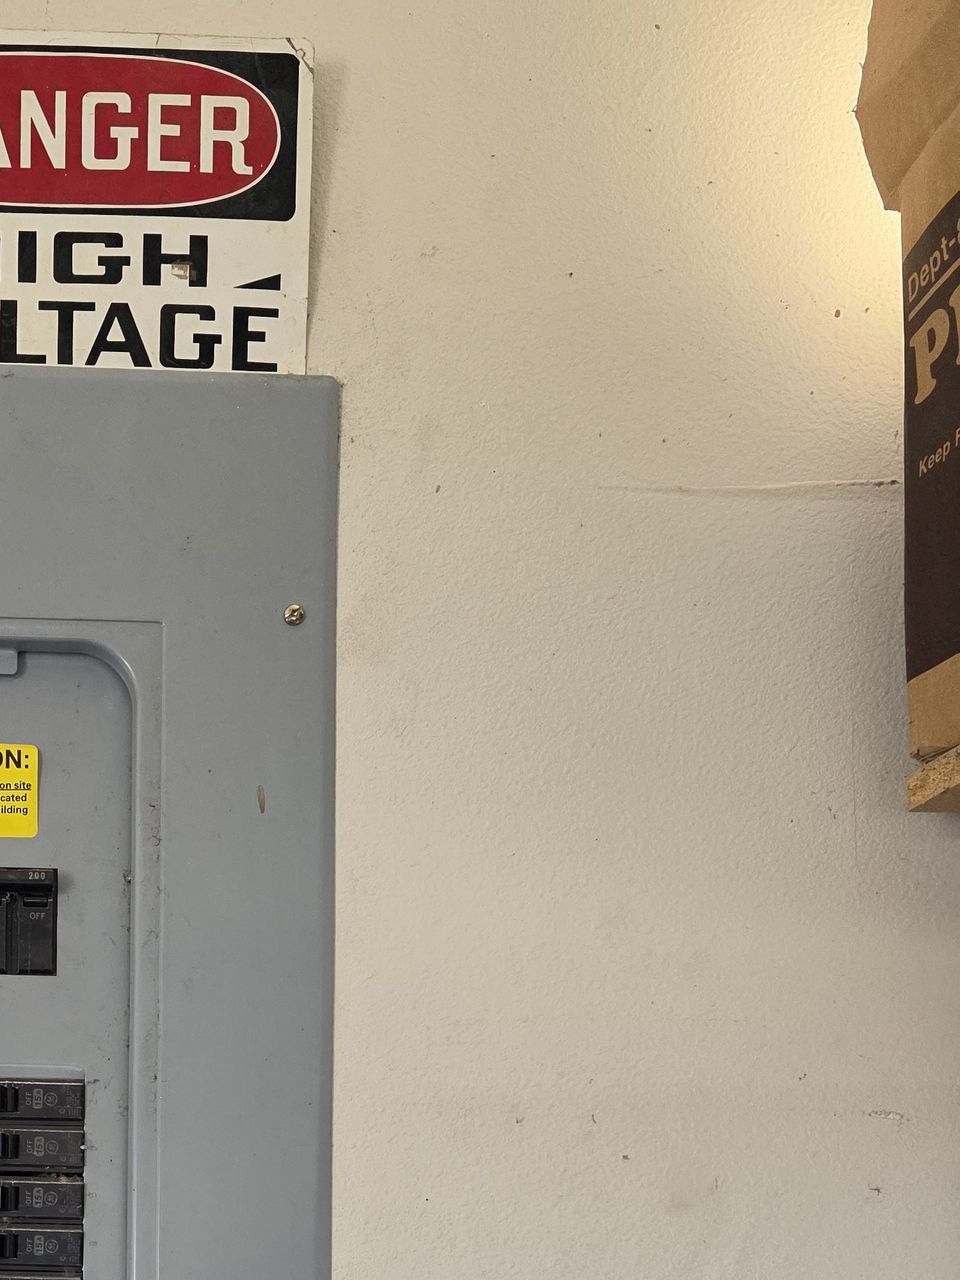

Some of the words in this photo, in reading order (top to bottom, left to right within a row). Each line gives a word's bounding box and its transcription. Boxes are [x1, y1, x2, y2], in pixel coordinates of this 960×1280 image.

[909, 284, 960, 405] P
[918, 439, 951, 477] Keep
[0, 782, 12, 790] on
[14, 781, 32, 790] site
[28, 872, 46, 880] 200
[29, 912, 46, 920] OFF
[33, 1089, 43, 1108] 15A
[34, 1137, 44, 1156] 15A
[33, 1187, 43, 1208] 15A
